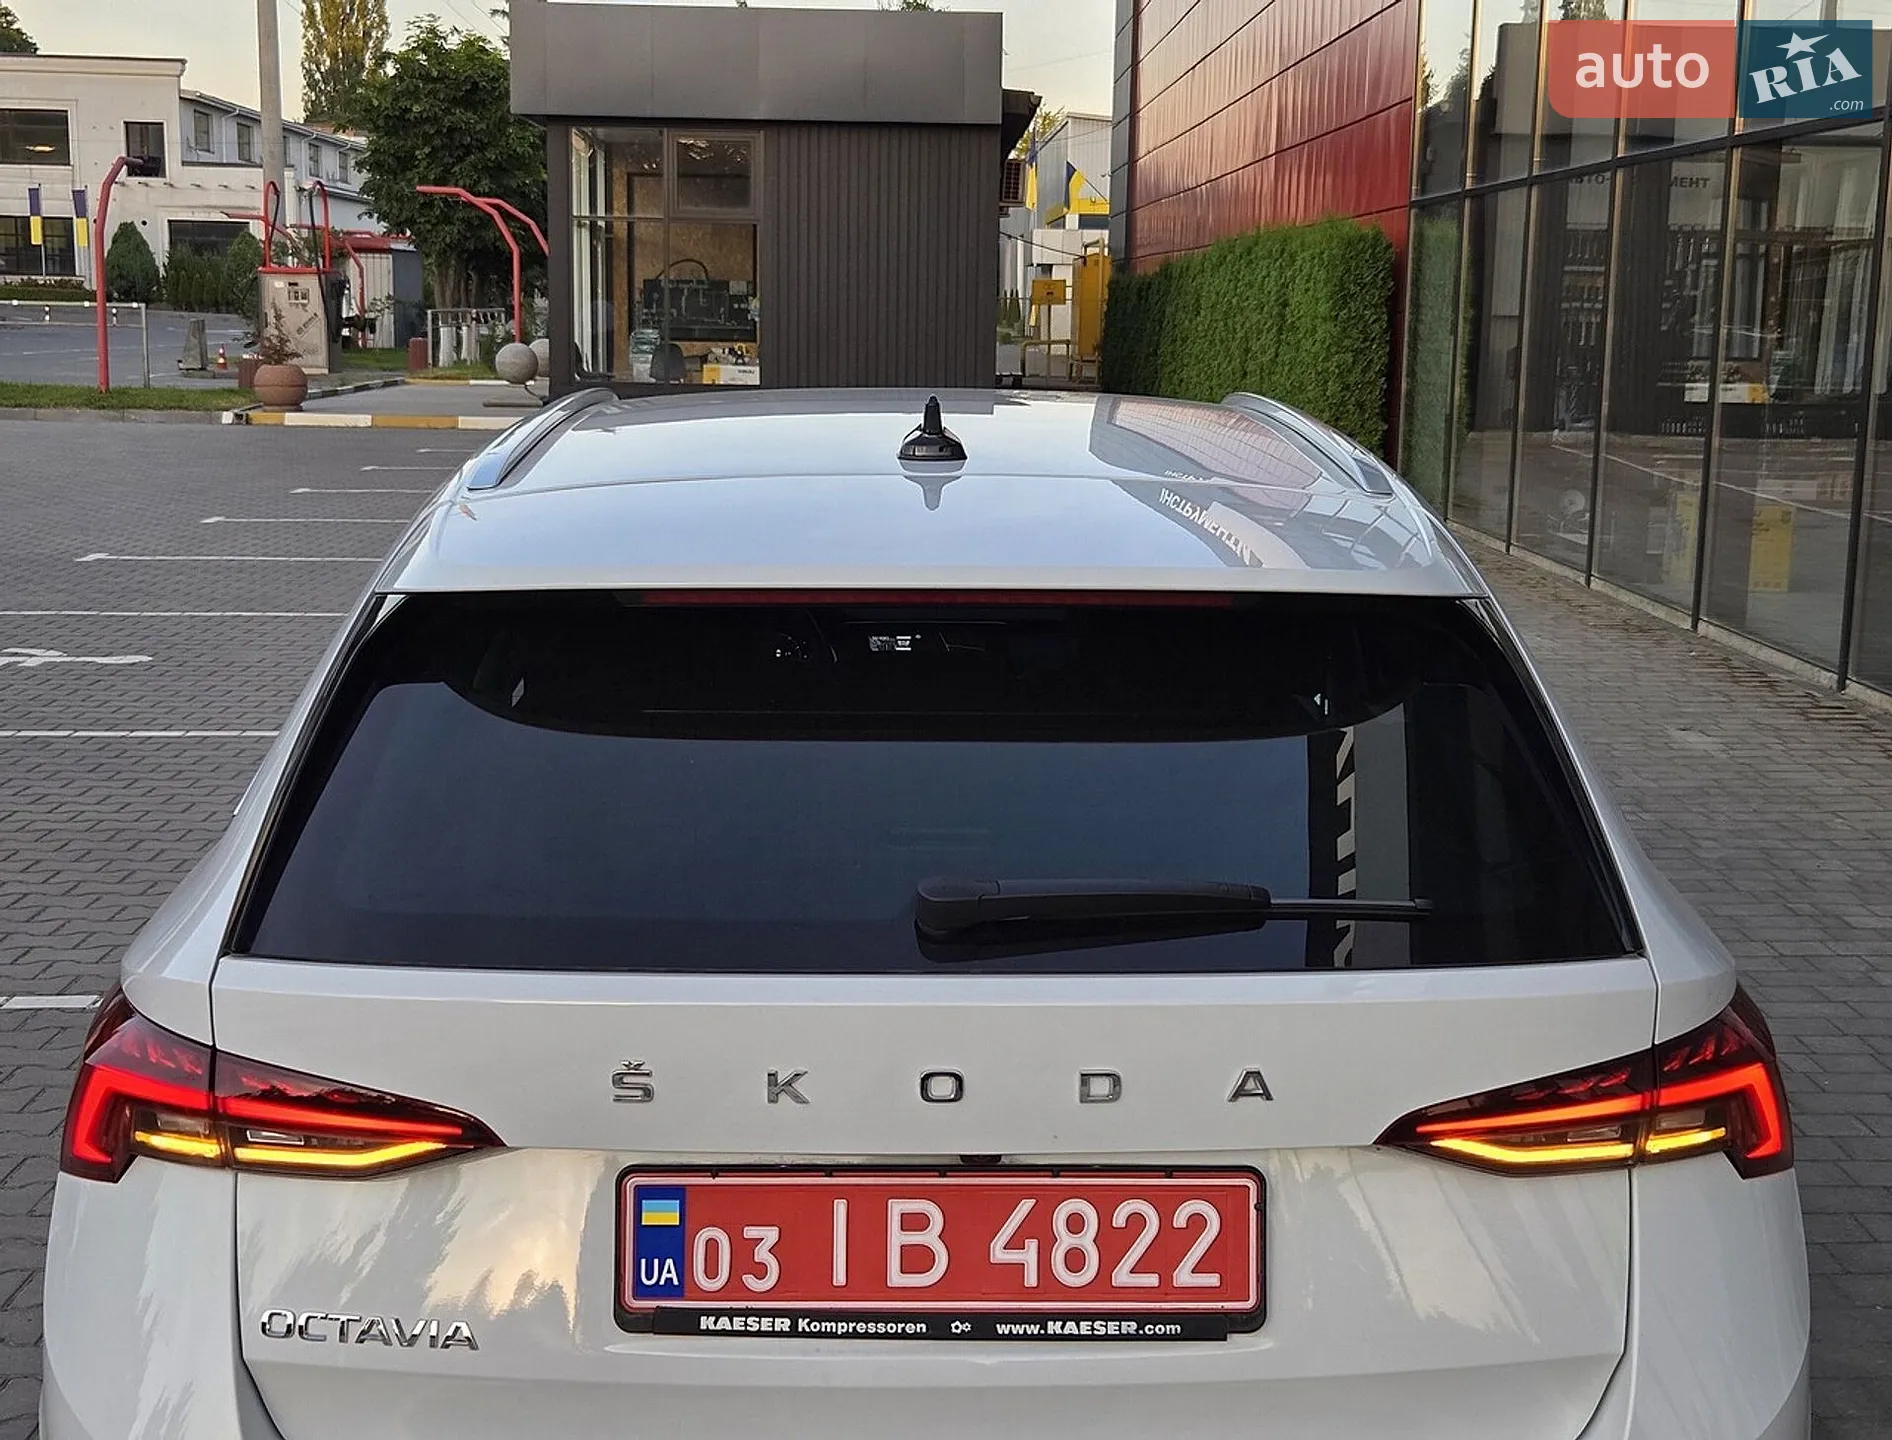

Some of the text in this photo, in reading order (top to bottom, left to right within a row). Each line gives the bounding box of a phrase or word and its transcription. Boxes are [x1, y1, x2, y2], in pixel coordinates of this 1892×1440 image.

[693, 1226, 780, 1292] 03
[990, 1198, 1221, 1288] 4822
[640, 1258, 679, 1286] UA
[261, 1308, 480, 1351] OCTAVIA
[700, 1315, 927, 1335] KAESER Kompressoren
[996, 1319, 1181, 1336] www.KAESER.com
